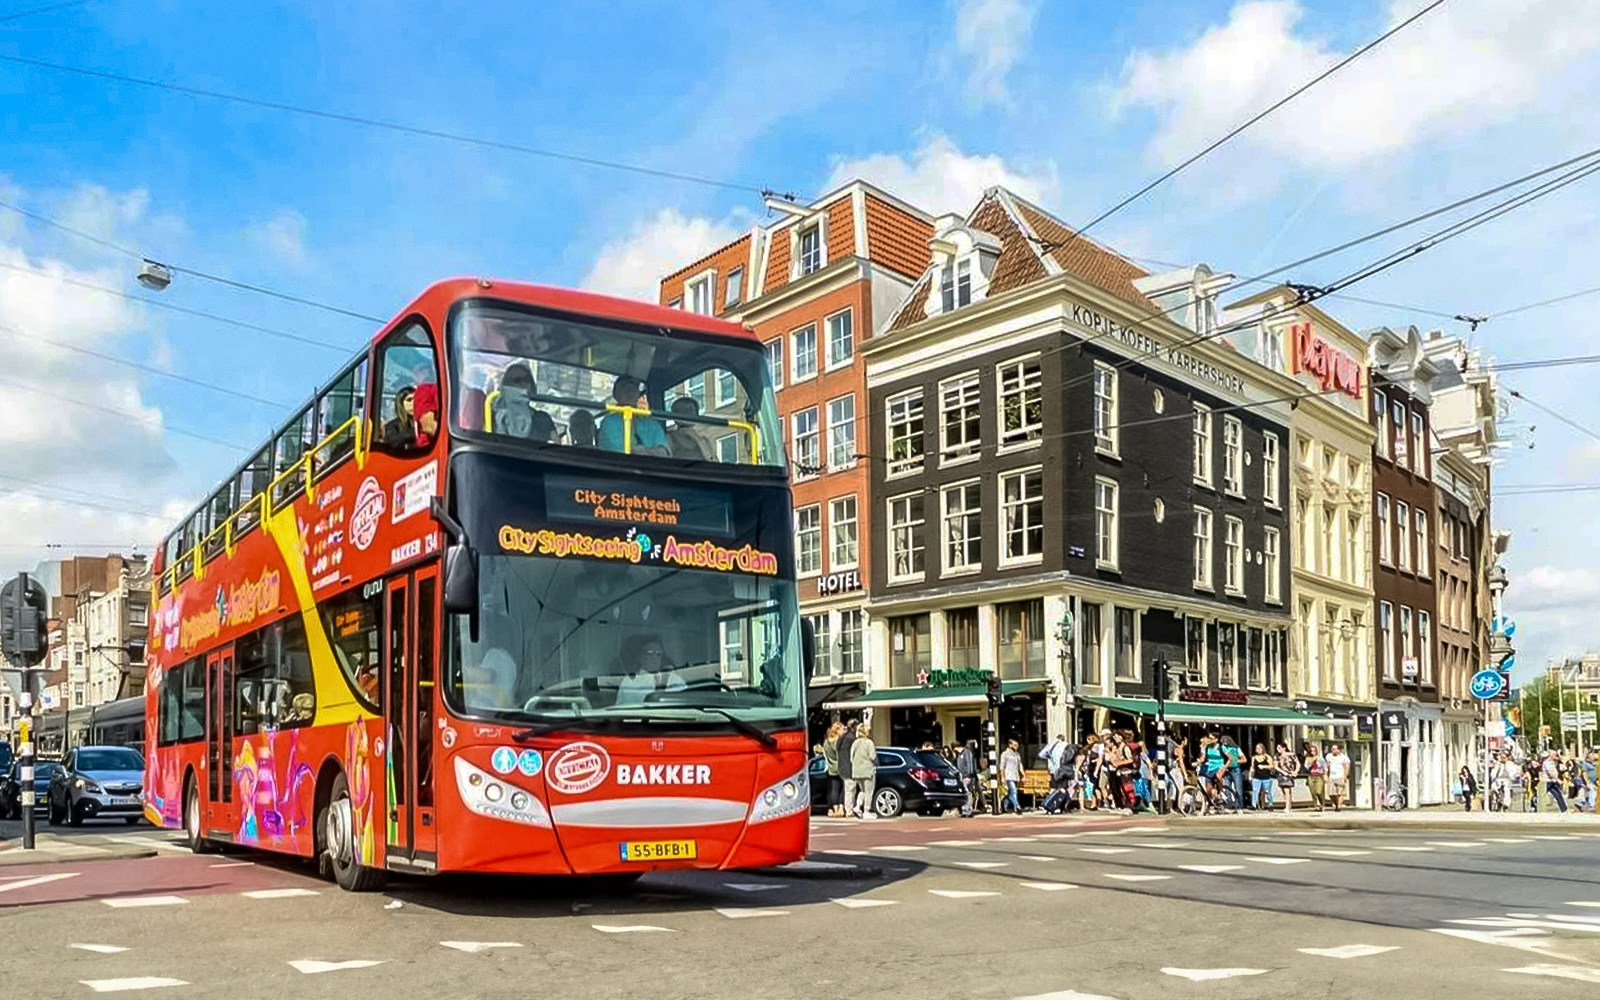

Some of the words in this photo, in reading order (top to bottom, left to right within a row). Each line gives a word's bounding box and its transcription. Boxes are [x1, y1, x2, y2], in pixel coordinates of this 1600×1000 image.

[1073, 303, 1115, 337] KOPJE
[1120, 327, 1160, 357] KOFFIE
[1167, 348, 1245, 395] KARPERSHOEK
[574, 489, 607, 505] City
[594, 505, 677, 525] Amsterdam
[498, 525, 537, 554] City
[538, 530, 642, 563] Sightseeing
[663, 535, 778, 576] Amsterdam
[817, 571, 860, 594] HOTEL
[616, 764, 712, 785] BAKKER
[633, 842, 690, 858] 55-BFB-1
